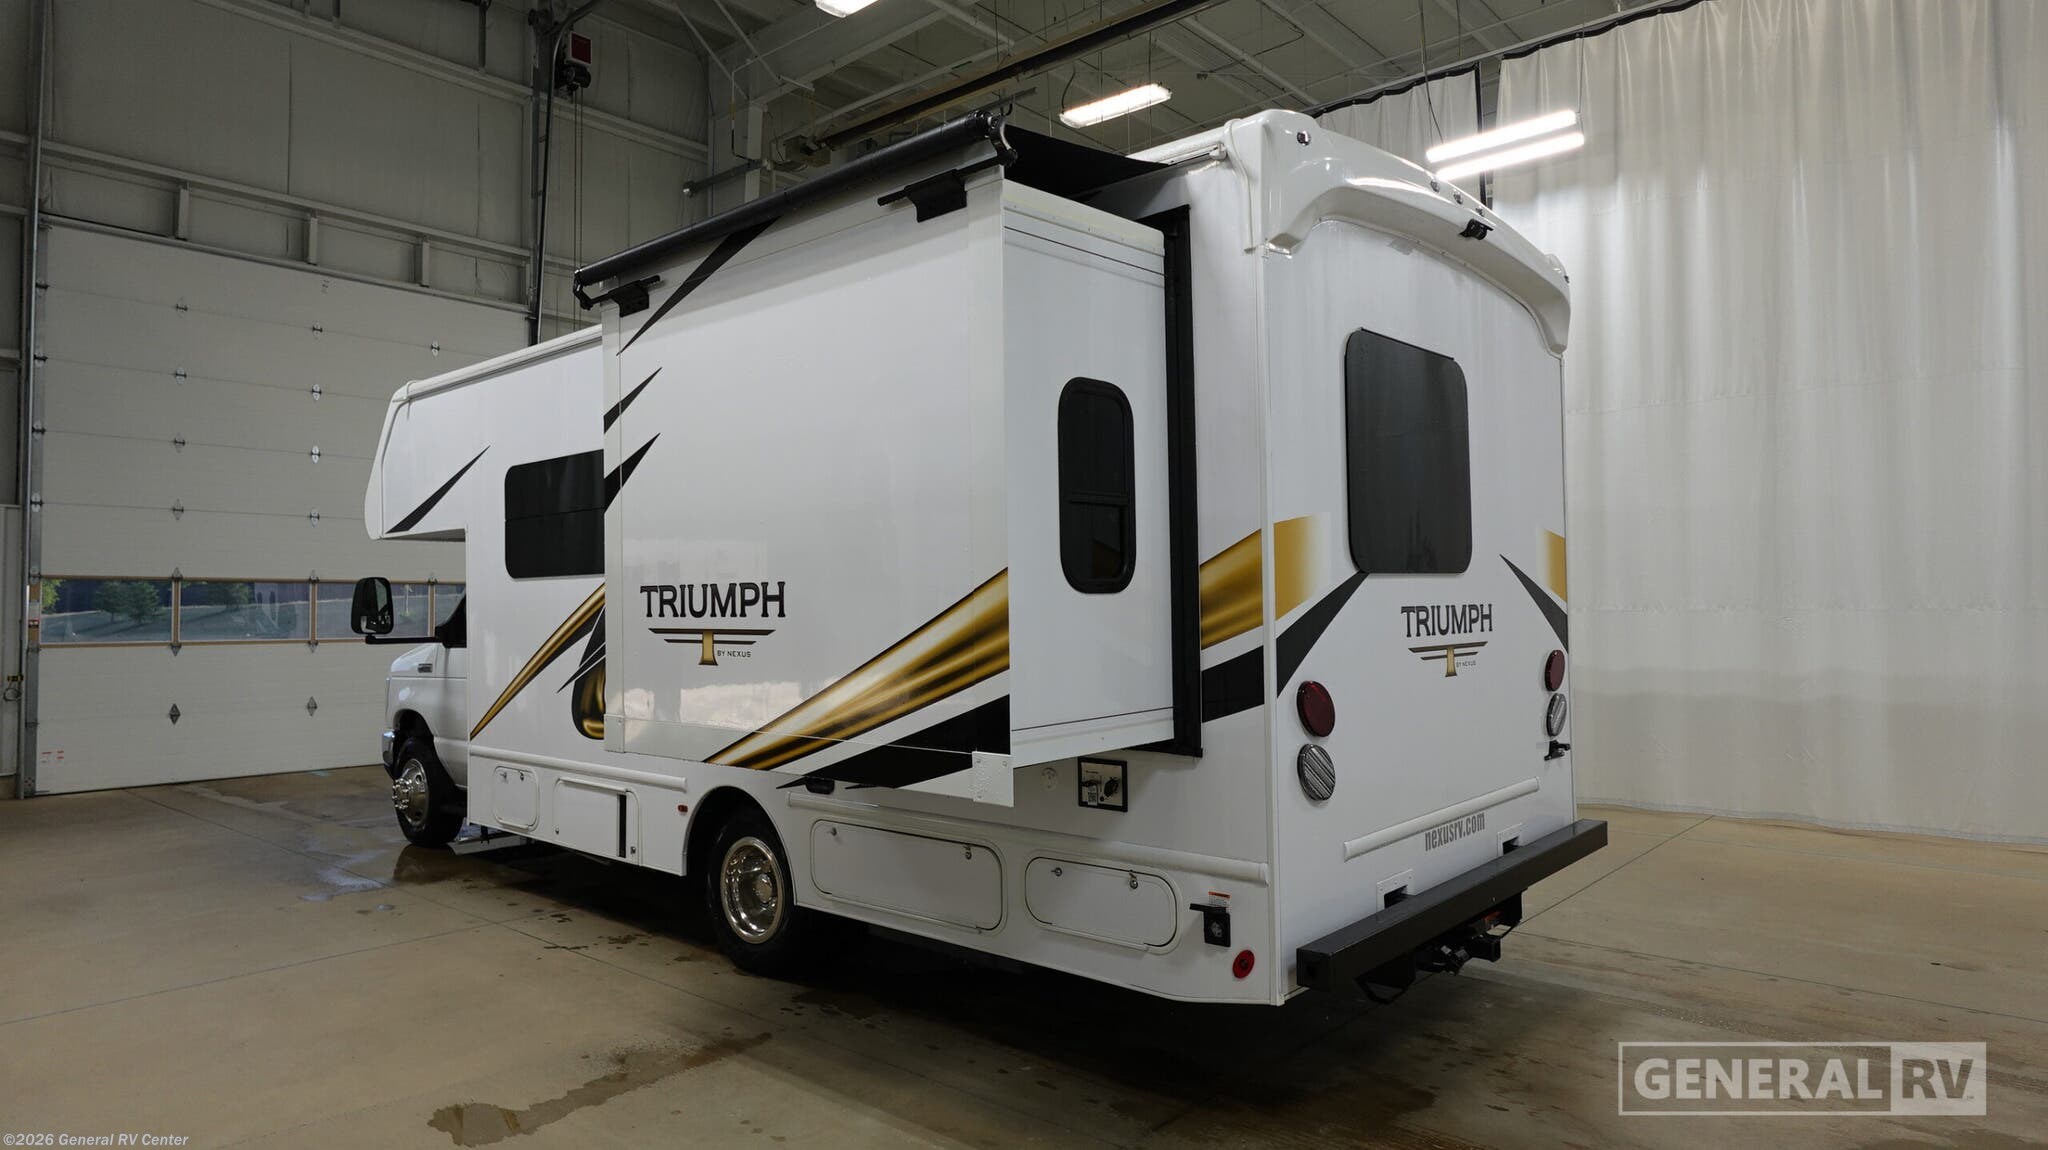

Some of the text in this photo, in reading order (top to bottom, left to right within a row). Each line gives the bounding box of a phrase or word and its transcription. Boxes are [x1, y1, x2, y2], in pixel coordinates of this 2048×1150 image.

[640, 581, 786, 618] TRIUMPH
[1401, 603, 1493, 638] TRIUMPH
[727, 650, 752, 658] NEXUS
[1424, 812, 1486, 852] nexusrv.com
